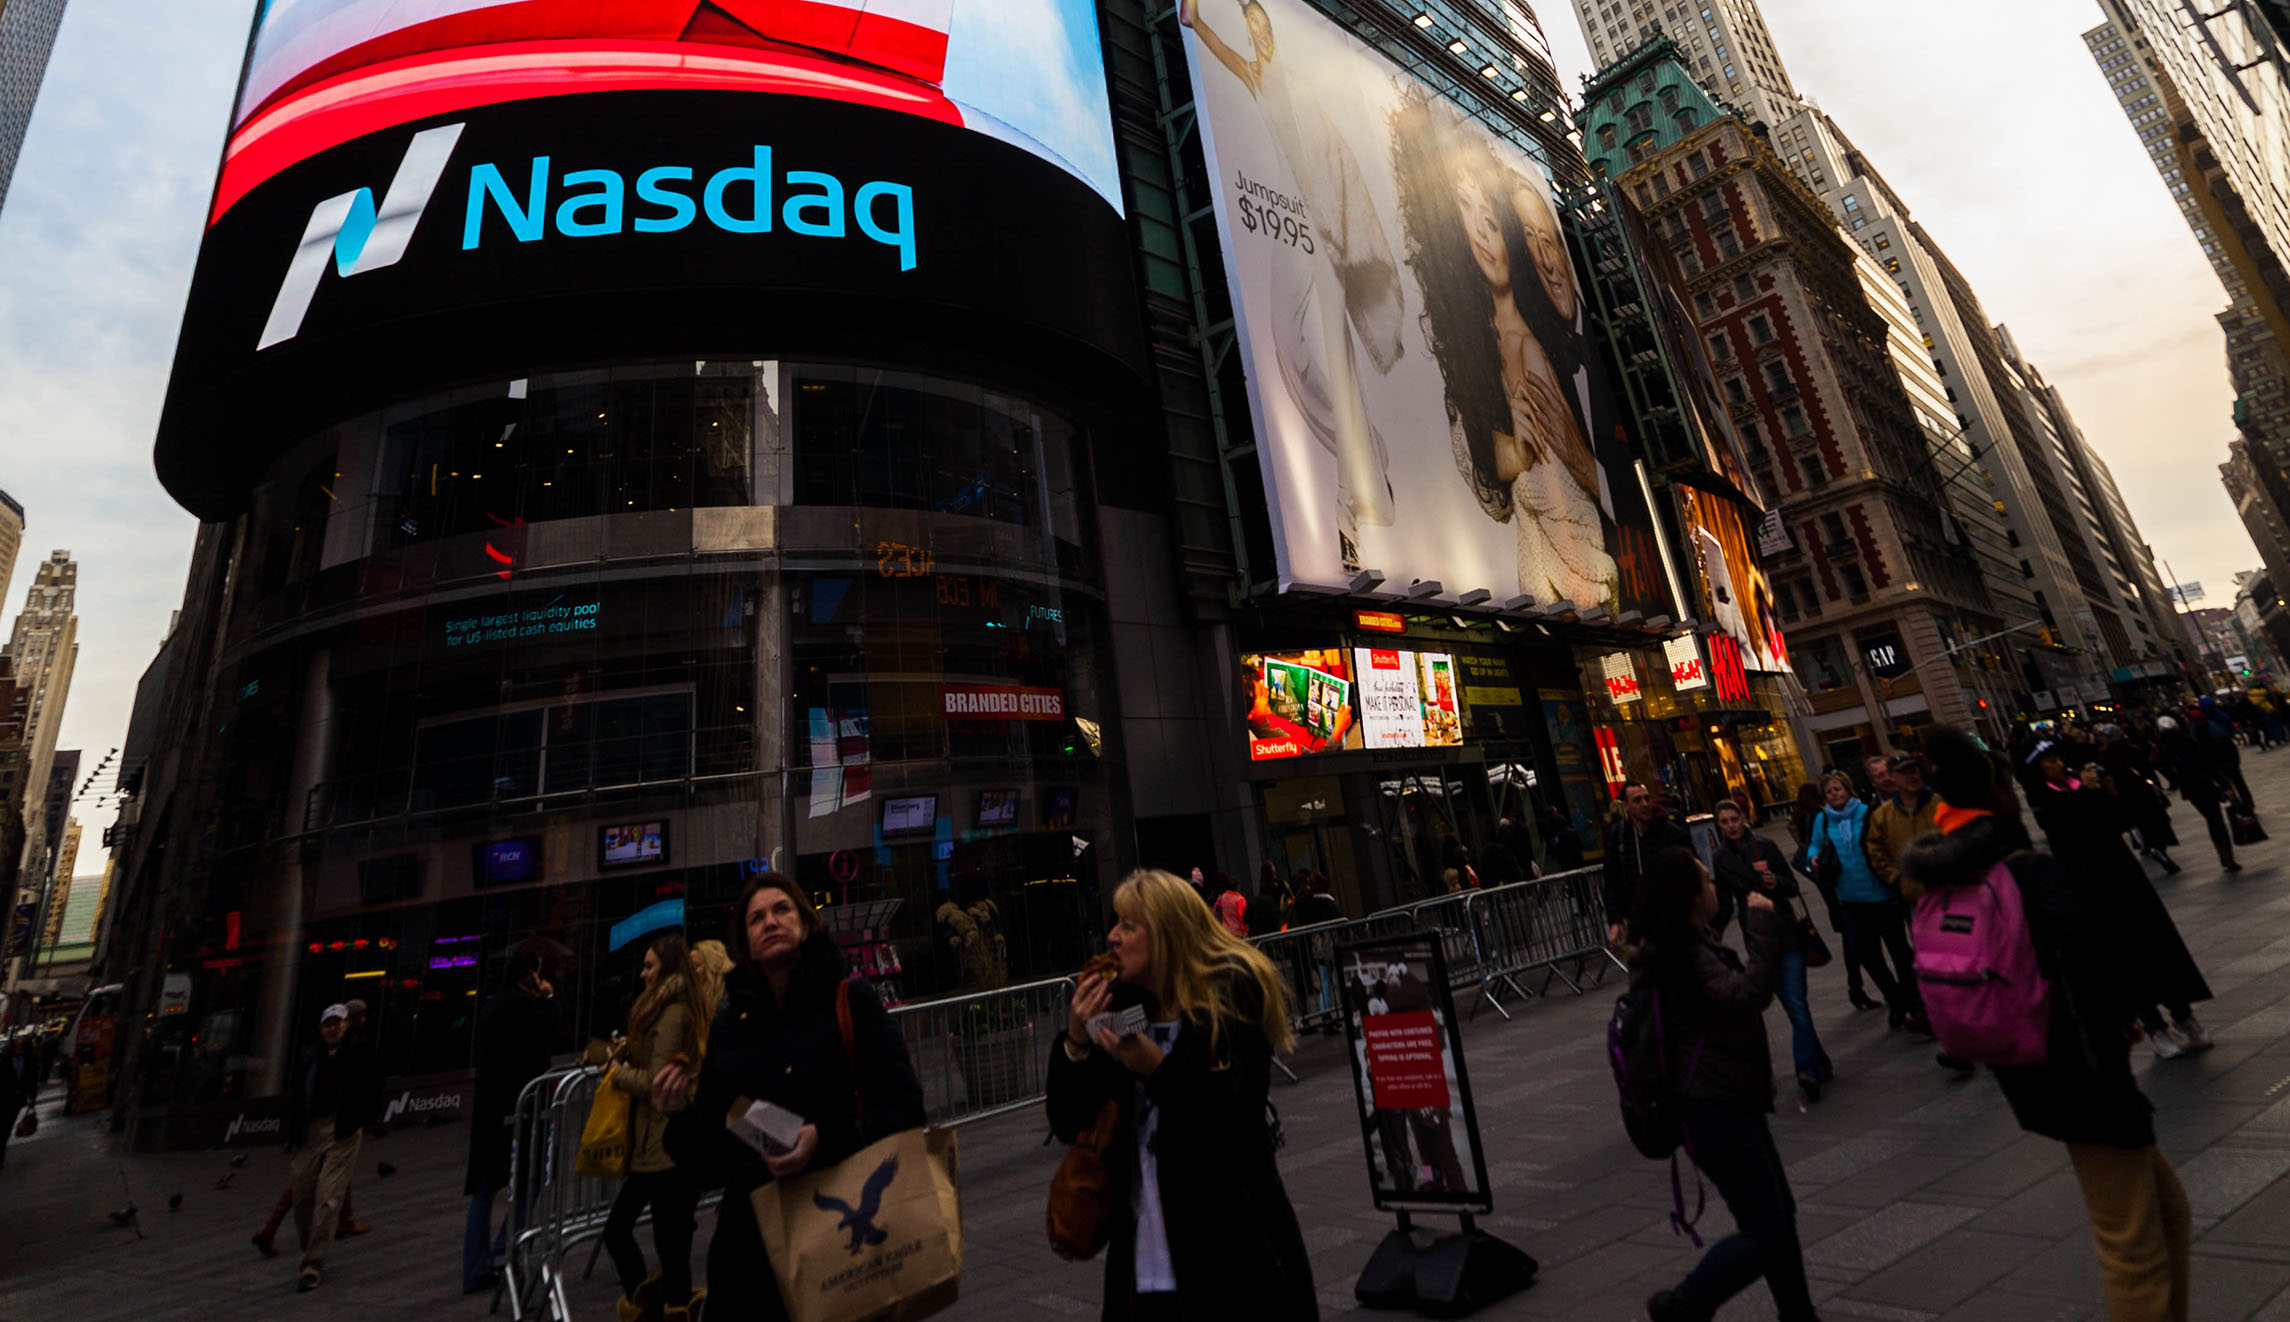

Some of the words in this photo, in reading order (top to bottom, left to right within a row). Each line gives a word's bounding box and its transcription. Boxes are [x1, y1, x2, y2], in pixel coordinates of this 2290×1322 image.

[1235, 170, 1306, 219] Jumpsuit
[462, 143, 917, 272] Nasdaq
[1239, 194, 1314, 255] $19.95
[445, 618, 478, 633] Single
[481, 612, 519, 628] largest
[522, 605, 570, 621] liquidity
[574, 602, 600, 616] pool
[1030, 605, 1062, 623] FUTURES
[447, 634, 463, 647] for
[519, 623, 546, 637] cash
[550, 618, 596, 633] equities
[1870, 645, 1895, 668] GAP
[945, 693, 1018, 713] BRANDED
[1019, 694, 1061, 714] CITIES
[1365, 696, 1382, 711] MAKE
[1256, 741, 1297, 755] Shutterfly
[408, 1092, 461, 1112] Nasdaq
[243, 1116, 280, 1134] Nasdaq
[820, 1256, 882, 1290] AMERICAN
